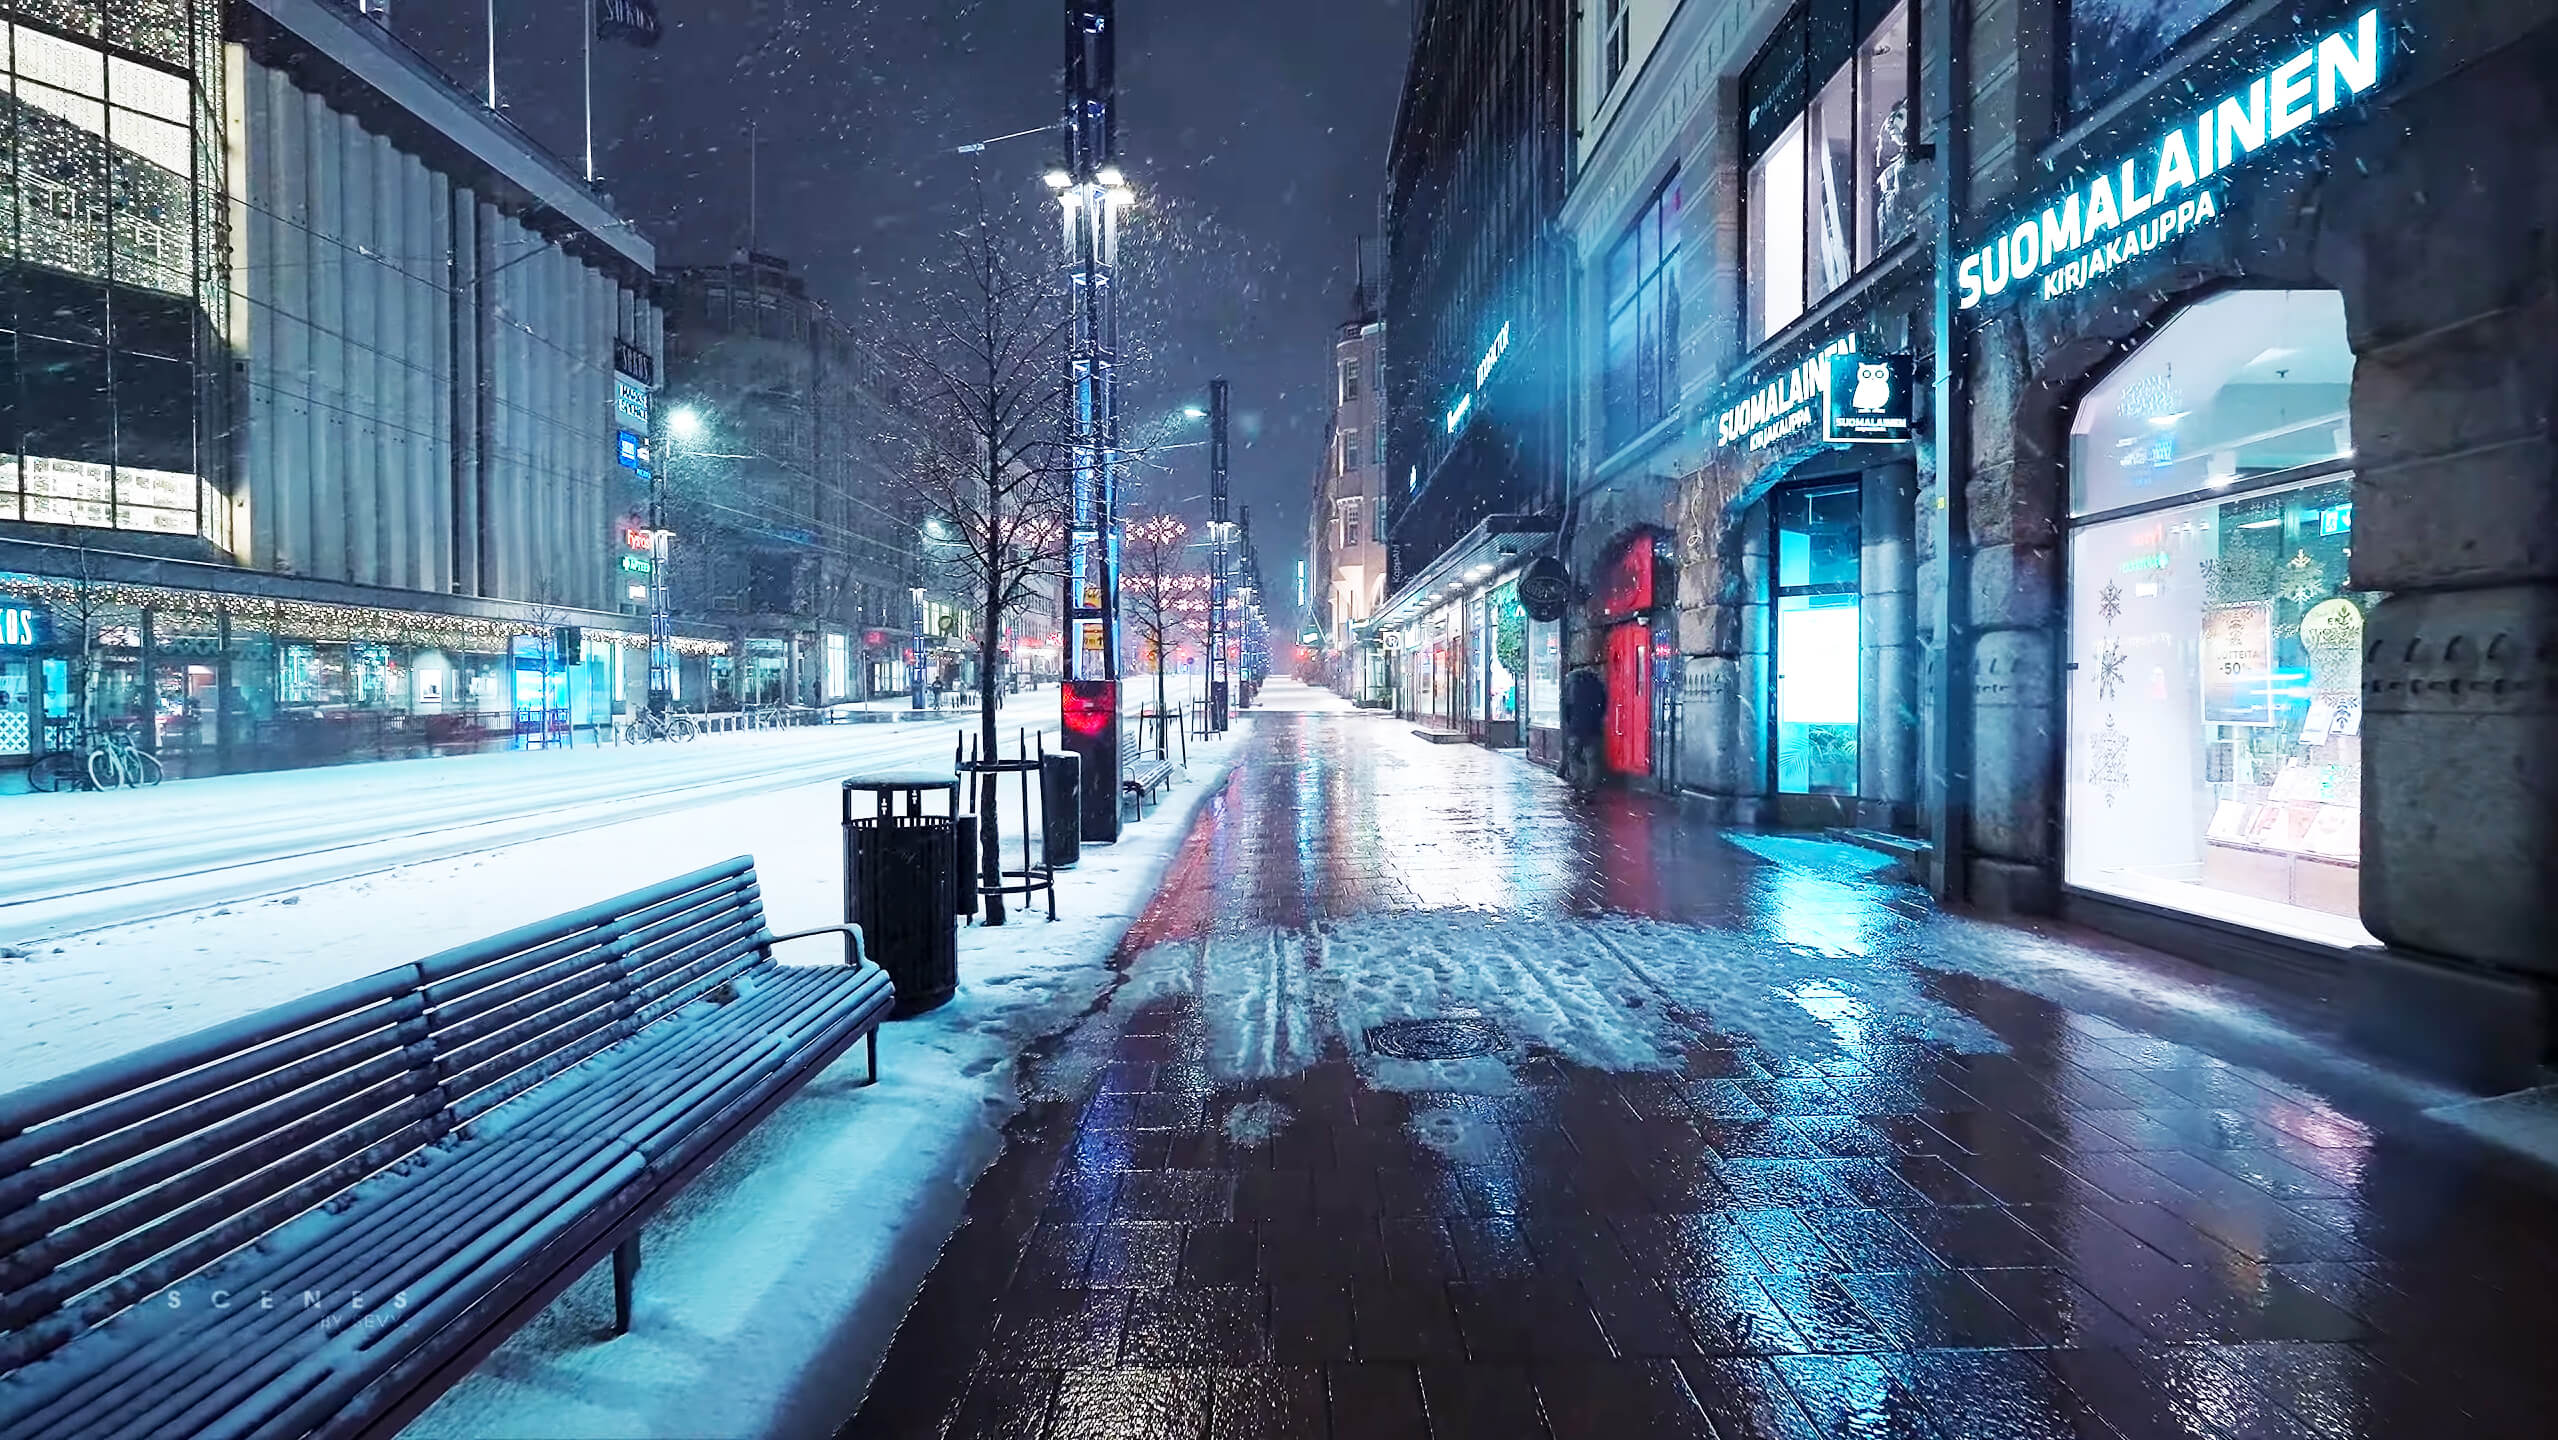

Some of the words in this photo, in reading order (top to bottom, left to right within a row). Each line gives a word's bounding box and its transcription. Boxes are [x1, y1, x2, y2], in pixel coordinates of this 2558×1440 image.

[1957, 8, 2378, 310] SUOMALAINEN
[2043, 190, 2216, 301] KIRJAKAUPPA
[1749, 406, 1812, 452] KIRJAKAUPPA
